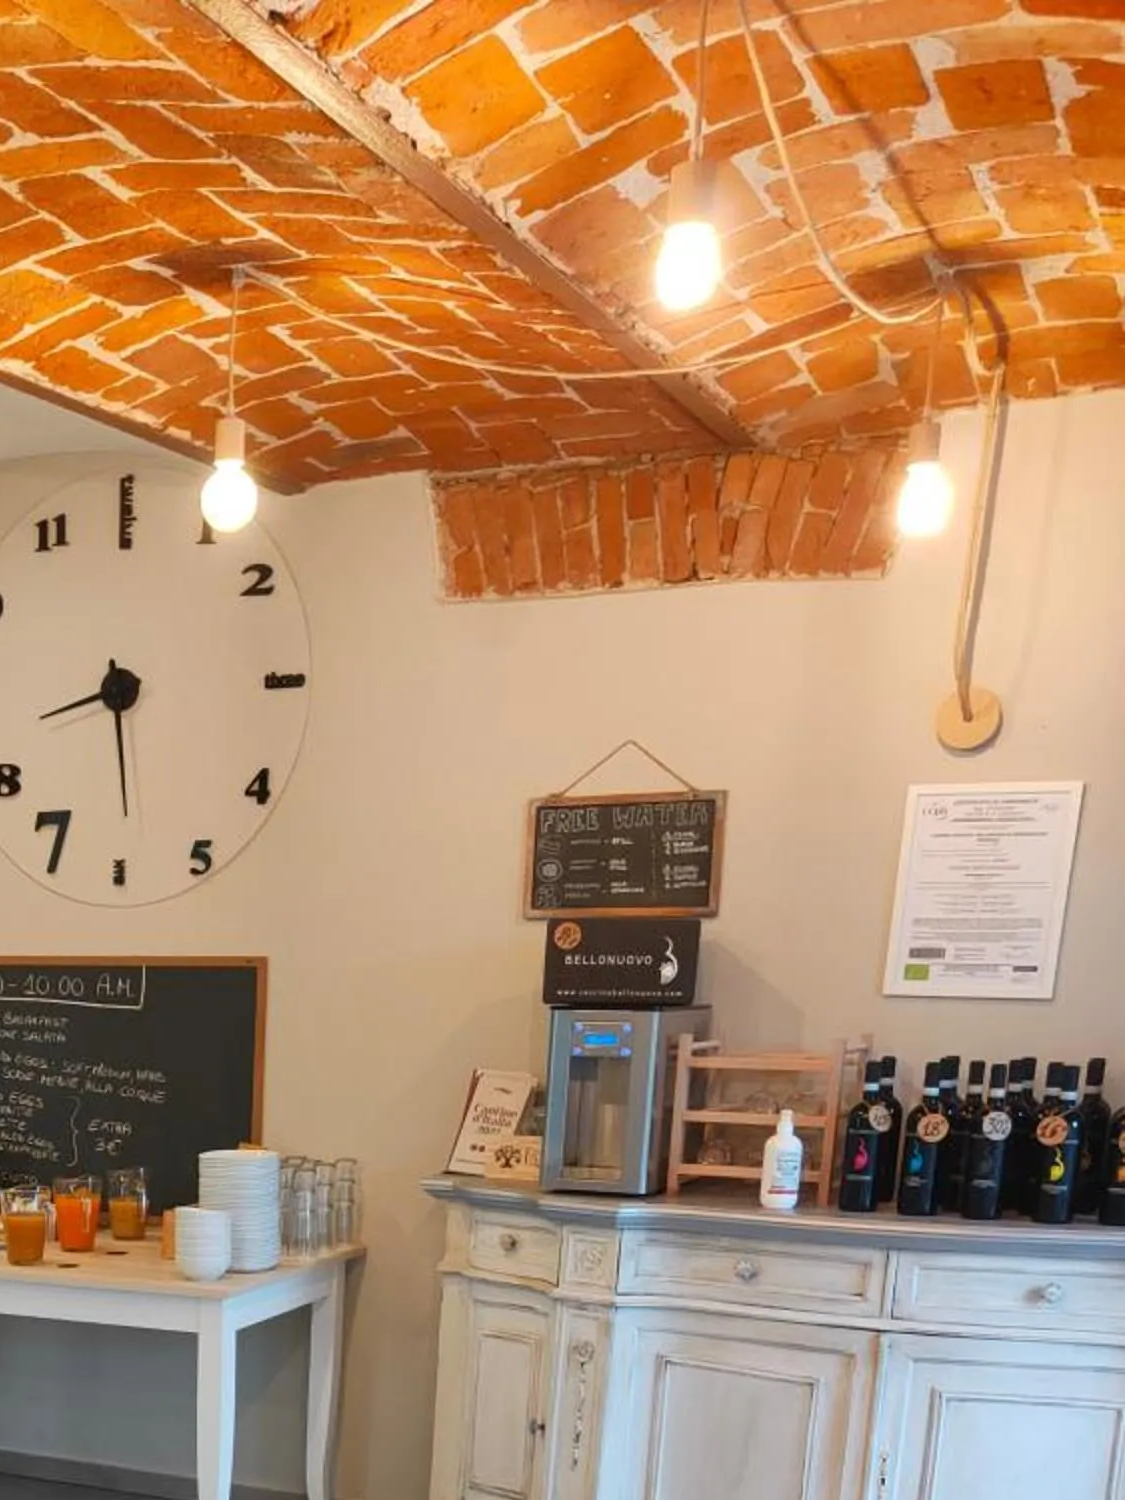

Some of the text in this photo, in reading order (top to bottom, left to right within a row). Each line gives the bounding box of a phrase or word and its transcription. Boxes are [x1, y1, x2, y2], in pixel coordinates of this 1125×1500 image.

[34, 513, 70, 552] 11
[240, 563, 275, 597] 2
[244, 768, 271, 805] 4
[540, 803, 709, 834] FREE WATER
[34, 809, 72, 875] 7
[189, 839, 213, 875] 5
[564, 954, 653, 966] BELLONUOVO
[88, 1118, 133, 1137] EXTRA
